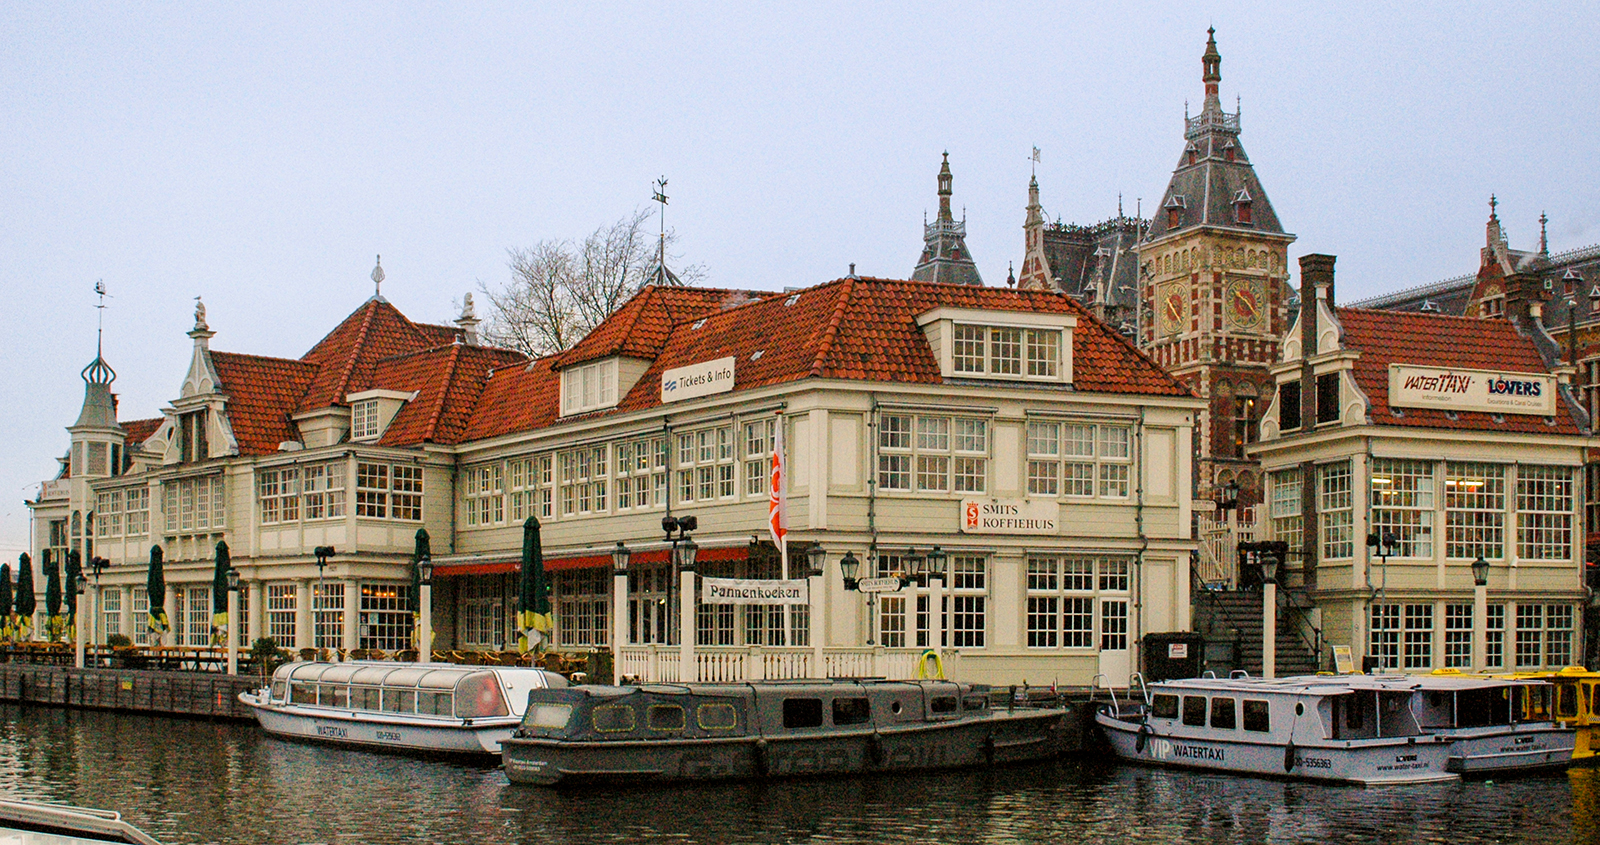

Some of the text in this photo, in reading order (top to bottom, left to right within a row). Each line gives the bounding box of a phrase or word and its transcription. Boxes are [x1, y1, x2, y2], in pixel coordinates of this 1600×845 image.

[680, 368, 731, 388] Tickets & Info
[1488, 379, 1542, 397] LOVERS
[1422, 394, 1452, 402] Information
[983, 504, 1018, 515] SMITS
[983, 518, 1054, 529] KOFFIEHUIS
[710, 584, 800, 599] Pannenkoeken
[317, 725, 348, 738] WATERTAXI
[1149, 738, 1225, 760] VIP WATERTAXI
[1294, 756, 1332, 769] 20-5356363
